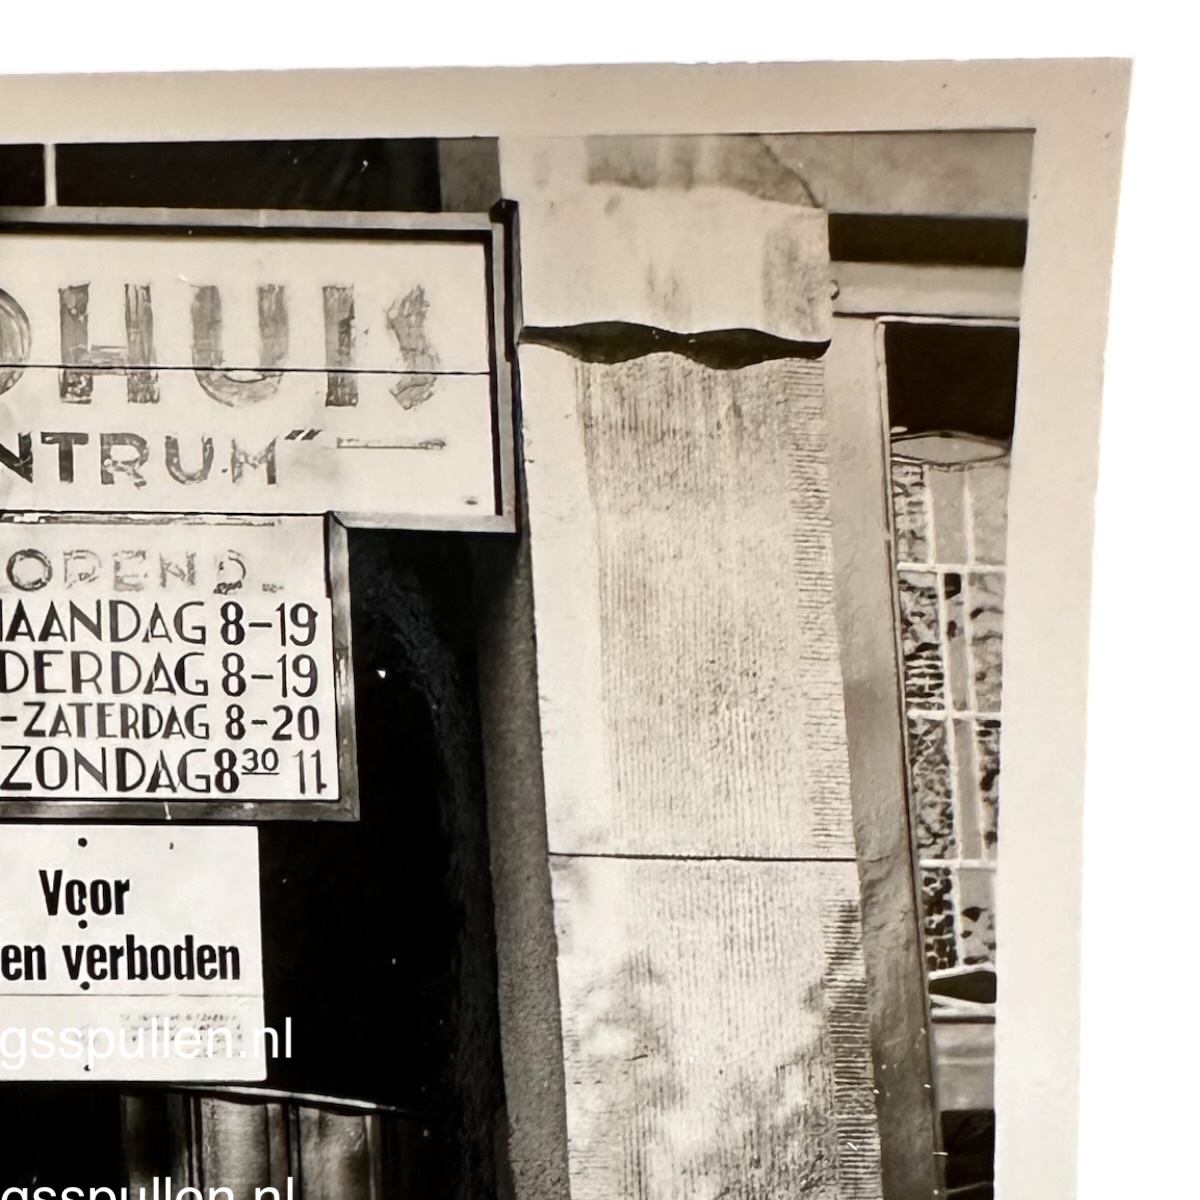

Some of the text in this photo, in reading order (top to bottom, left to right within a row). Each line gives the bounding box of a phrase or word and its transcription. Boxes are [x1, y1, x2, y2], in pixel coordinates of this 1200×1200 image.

[220, 601, 319, 647] 8-19
[221, 652, 318, 698] 8-19
[225, 703, 320, 742] 8-20
[0, 745, 211, 794] ZONDAG
[38, 869, 130, 916] Voor
[62, 934, 241, 981] verboden
